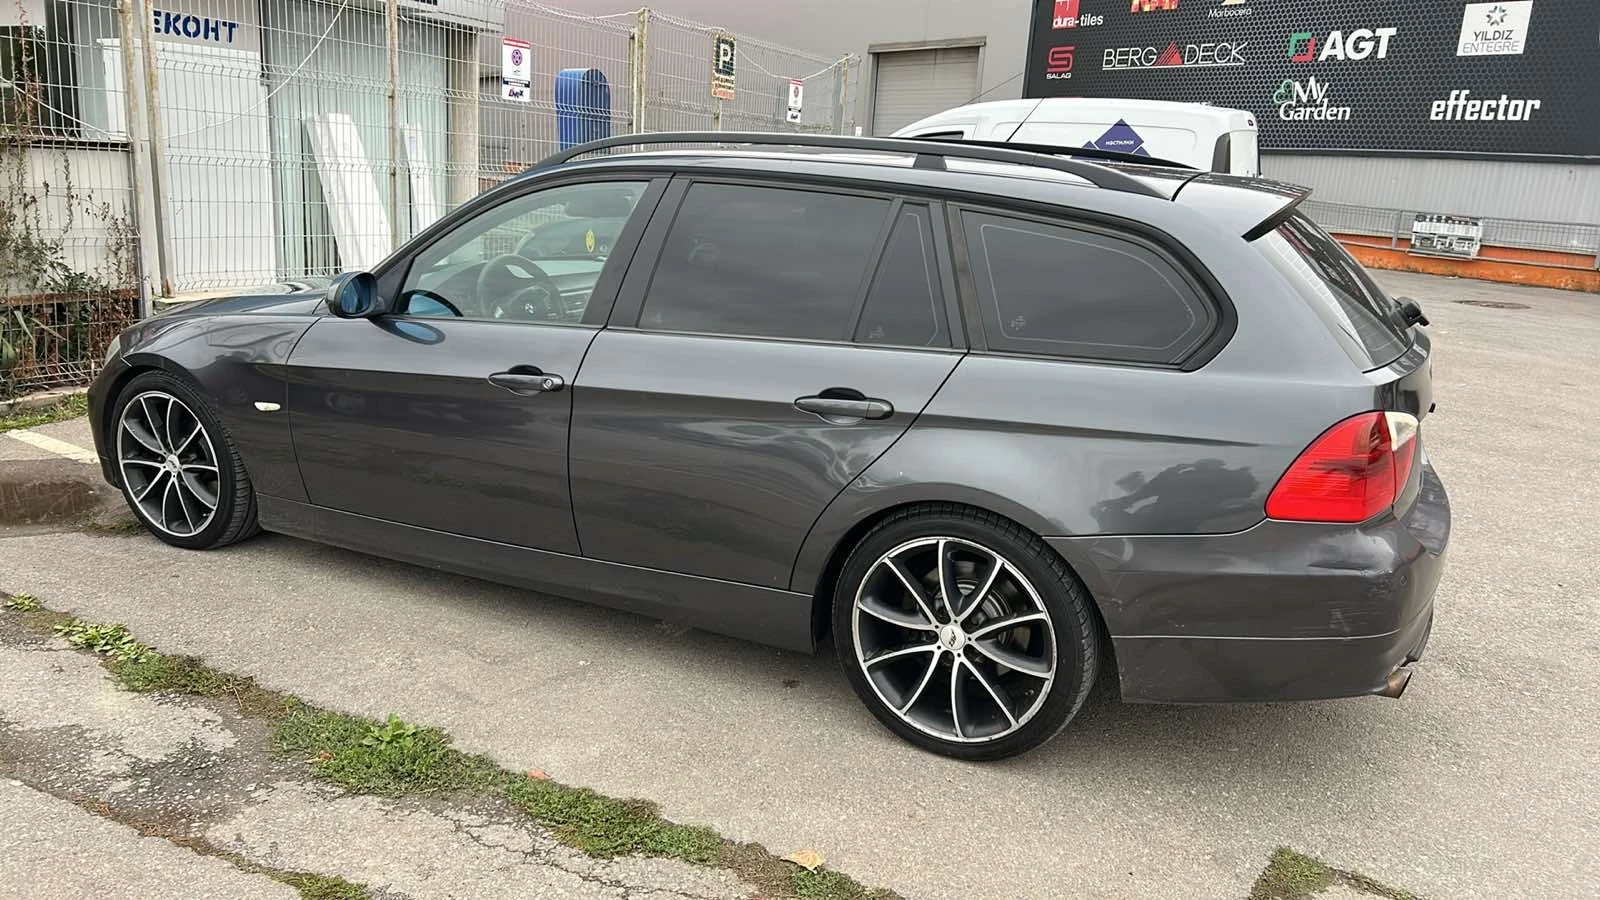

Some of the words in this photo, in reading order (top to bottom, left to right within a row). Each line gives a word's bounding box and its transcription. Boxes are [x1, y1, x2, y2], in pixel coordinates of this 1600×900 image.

[1053, 13, 1104, 28] dura-tiles
[1318, 27, 1397, 61] AGT
[1462, 40, 1520, 54] ENTEGRE
[1473, 29, 1514, 42] YILDIZ
[1102, 47, 1157, 68] BERG
[1184, 41, 1248, 65] DECK
[1291, 75, 1330, 106] My
[1279, 98, 1351, 121] Garden
[1430, 89, 1541, 121] effector
